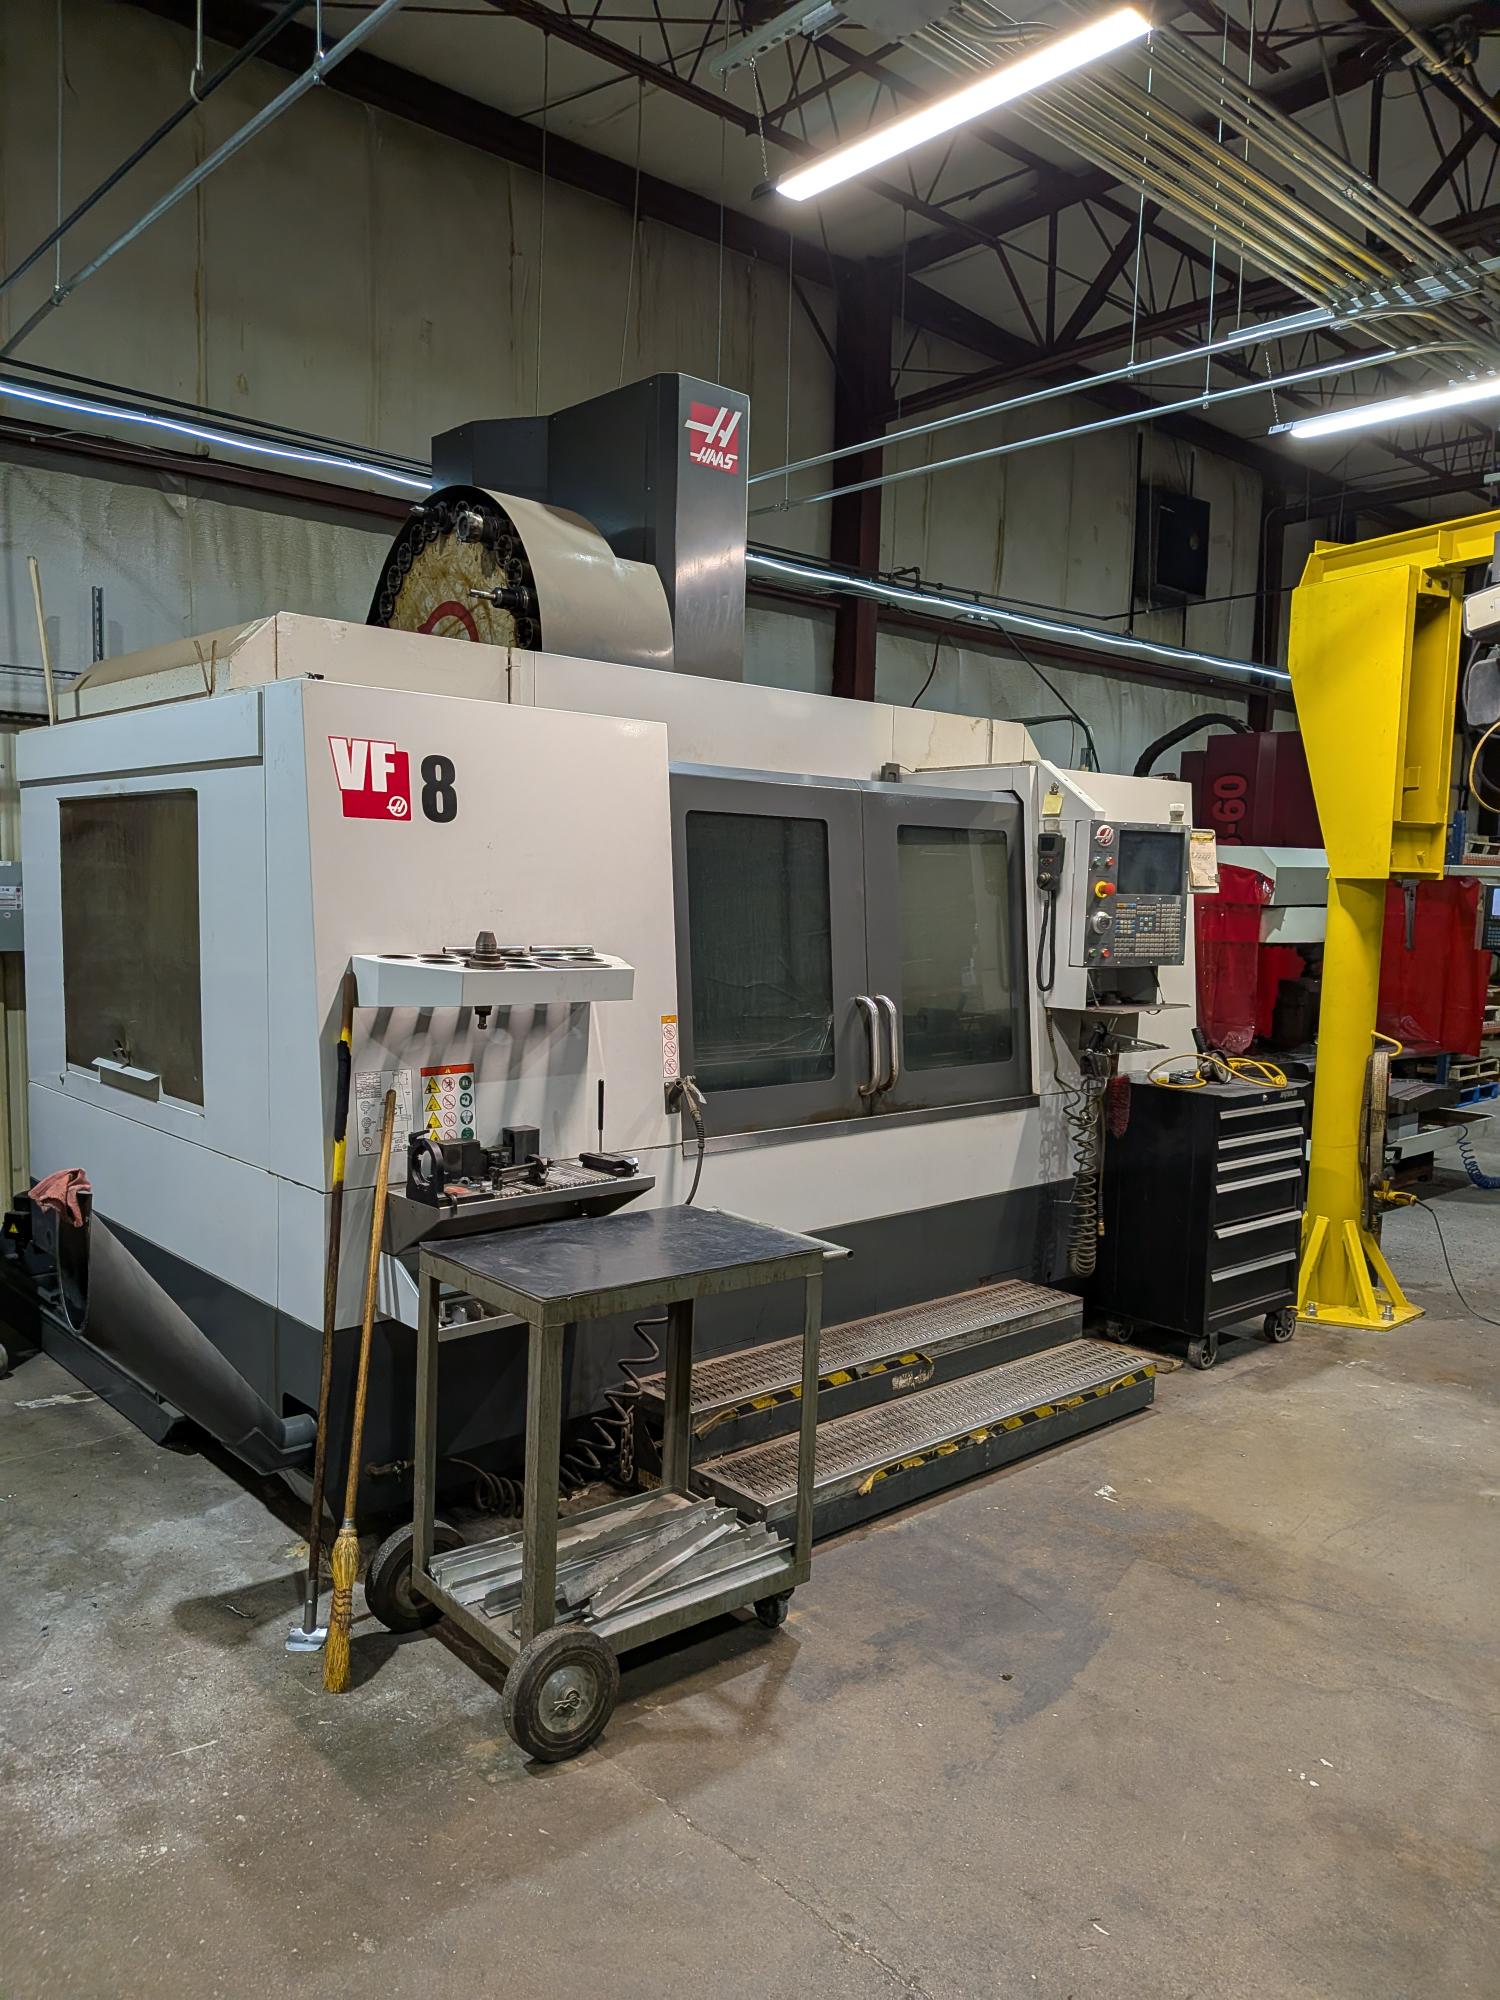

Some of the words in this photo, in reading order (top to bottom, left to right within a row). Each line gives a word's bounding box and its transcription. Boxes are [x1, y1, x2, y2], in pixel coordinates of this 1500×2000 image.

[690, 446, 738, 469] HAAS
[328, 736, 396, 793] VF
[421, 754, 458, 824] 8
